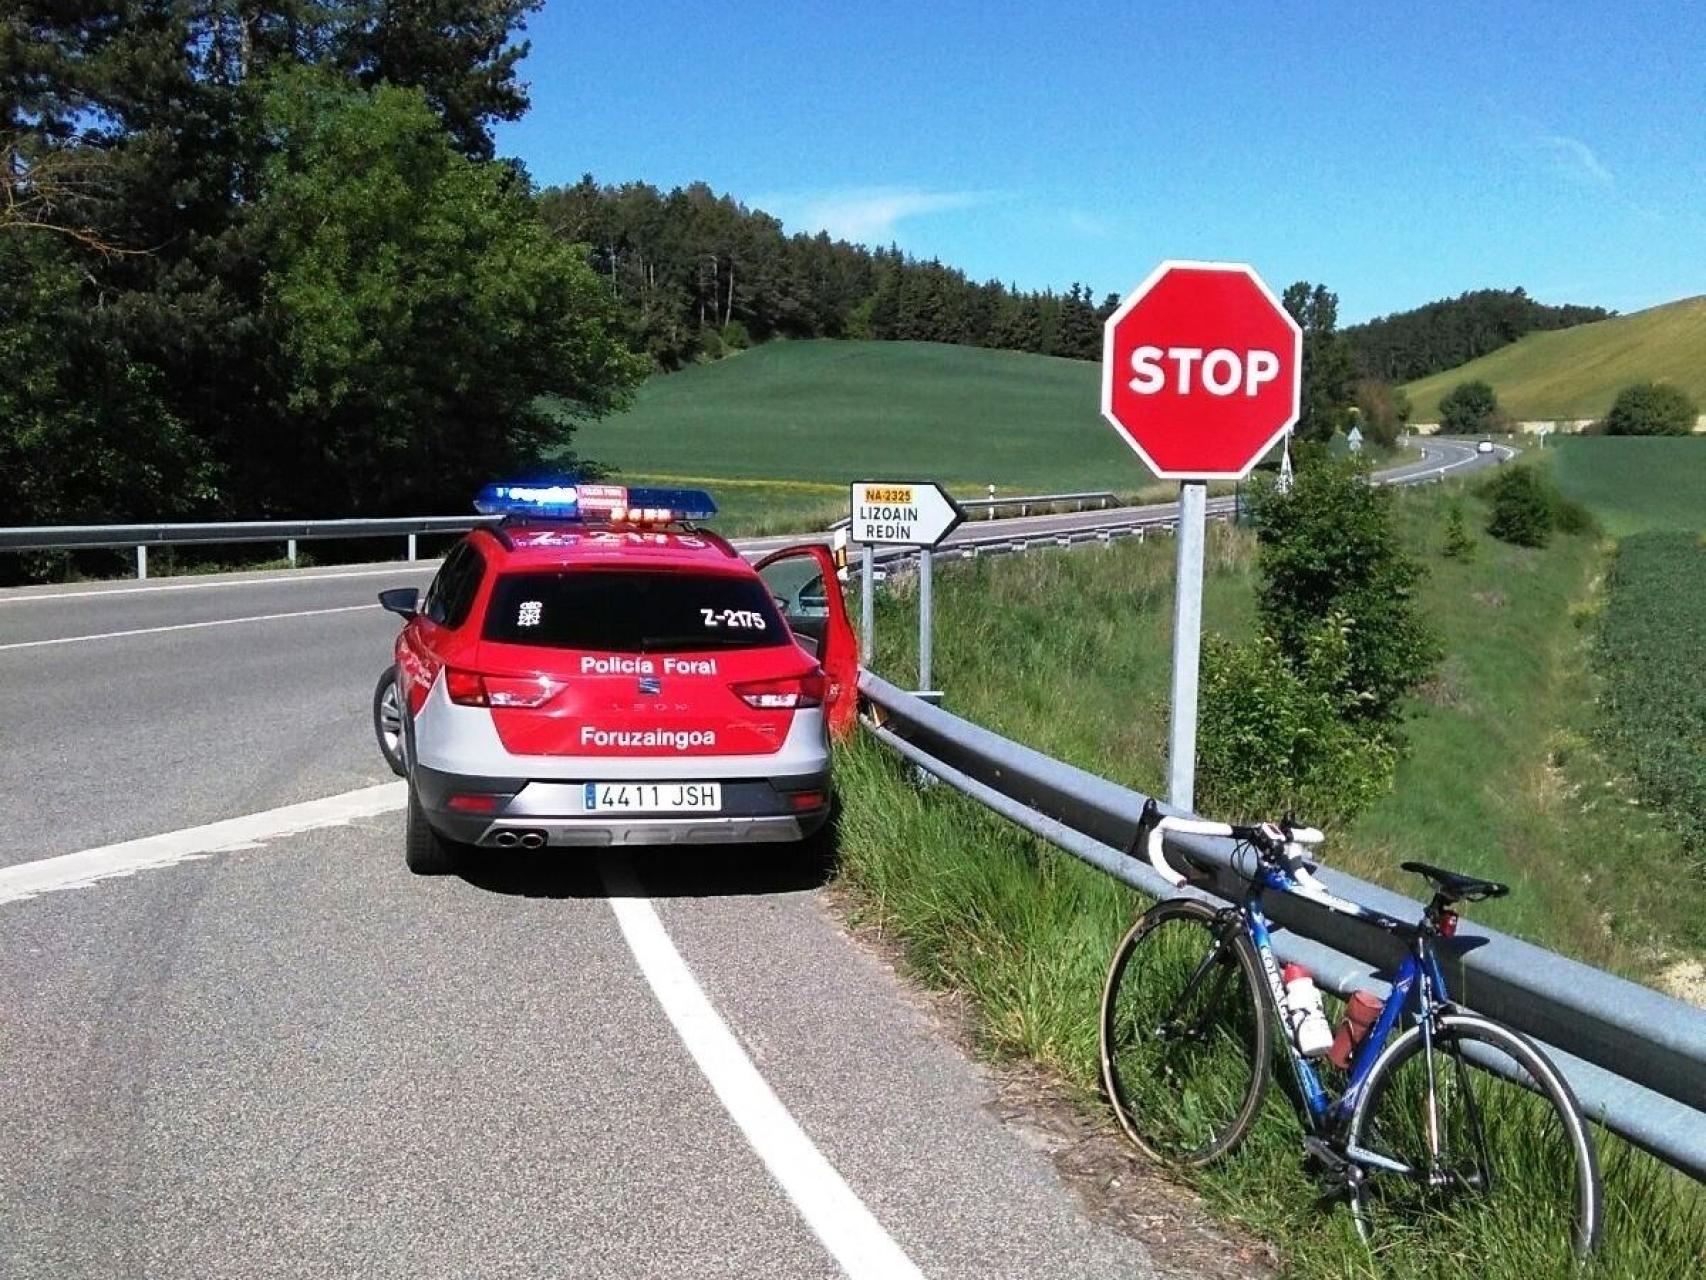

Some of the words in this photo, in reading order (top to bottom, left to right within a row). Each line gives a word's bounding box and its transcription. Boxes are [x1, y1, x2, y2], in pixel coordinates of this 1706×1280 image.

[1128, 345, 1280, 396] STOP
[865, 490, 911, 501] NA-2325
[860, 506, 918, 521] LIZOAIN
[866, 522, 911, 539] REDÍN
[700, 608, 766, 630] Z-2175
[580, 656, 654, 674] Policía
[663, 657, 717, 675] Foral
[580, 726, 716, 750] Foruzaingoa
[602, 785, 659, 807] 4411
[672, 785, 715, 806] JSH
